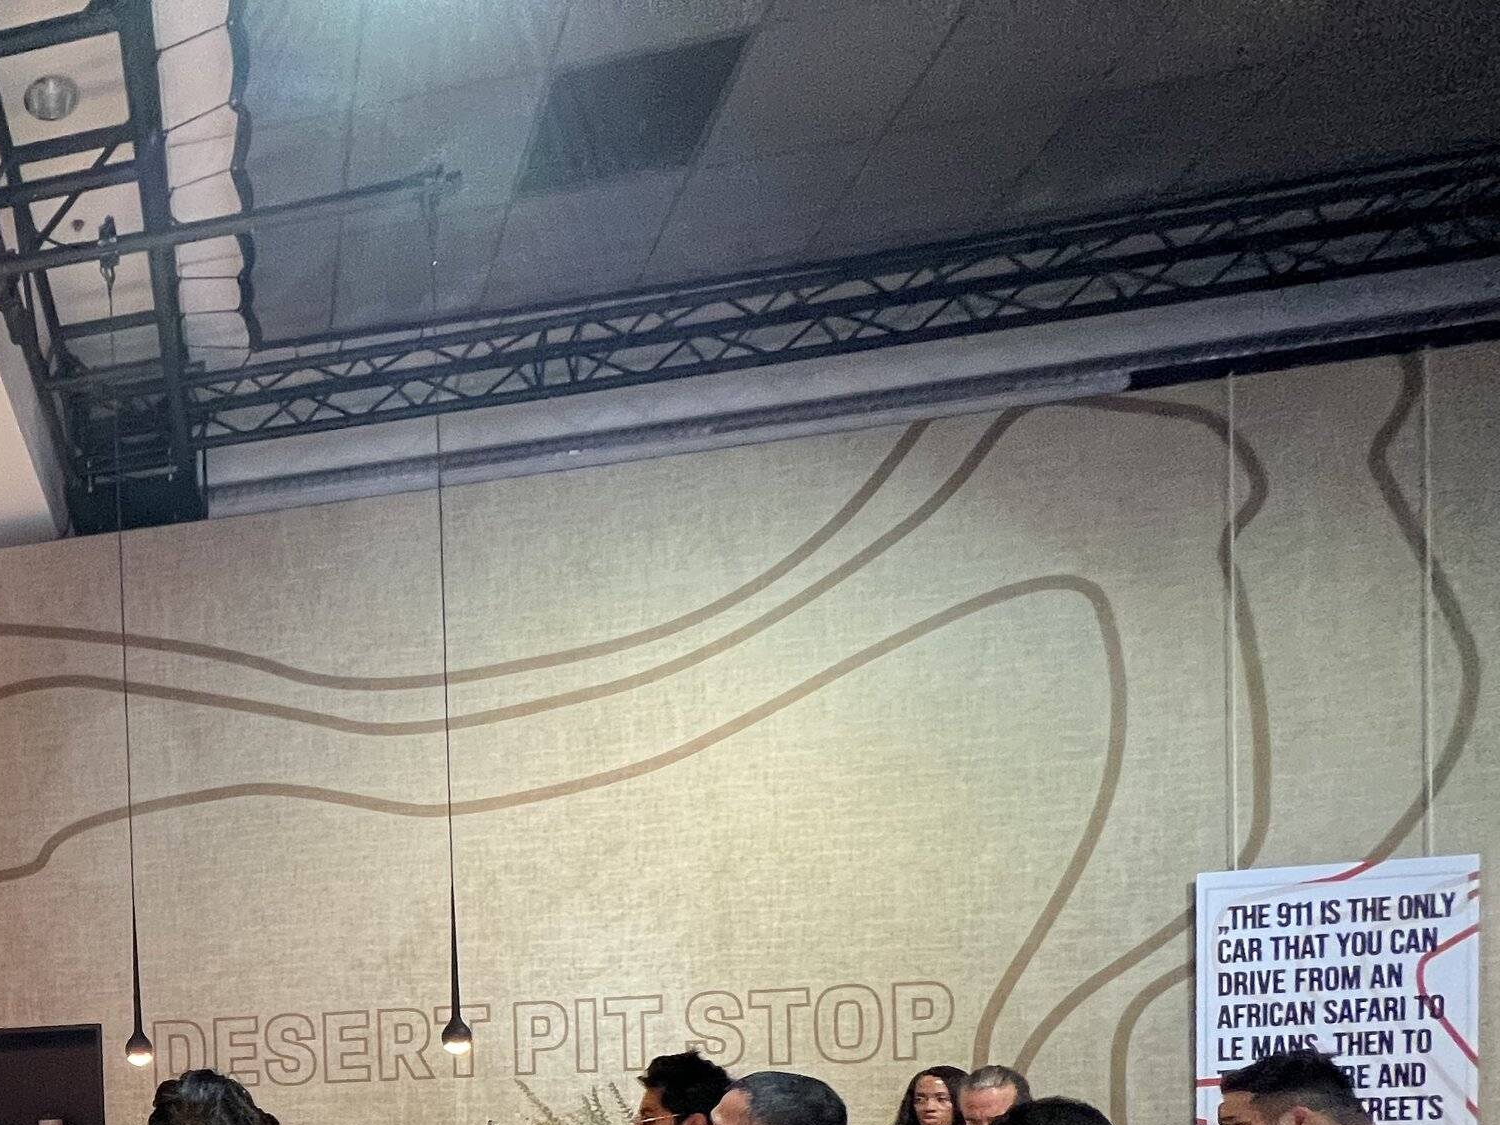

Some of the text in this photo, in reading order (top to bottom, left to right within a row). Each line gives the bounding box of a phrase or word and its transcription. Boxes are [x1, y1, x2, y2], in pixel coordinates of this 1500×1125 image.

[1277, 902, 1312, 927] 911
[1321, 900, 1341, 925] IS
[1347, 896, 1392, 923] THE
[1399, 892, 1456, 921] ONLY
[1218, 927, 1439, 964] CAR THAT YOU CAN
[1217, 963, 1403, 997] DRIVE FROM AN
[1217, 994, 1445, 1029] AFRICAN SAFARI TO
[153, 981, 956, 1088] DESERT PIT STOP
[1218, 1036, 1244, 1061] LE
[1332, 1030, 1394, 1056] THEN
[1402, 1029, 1432, 1055] TO
[1378, 1062, 1427, 1088] AND
